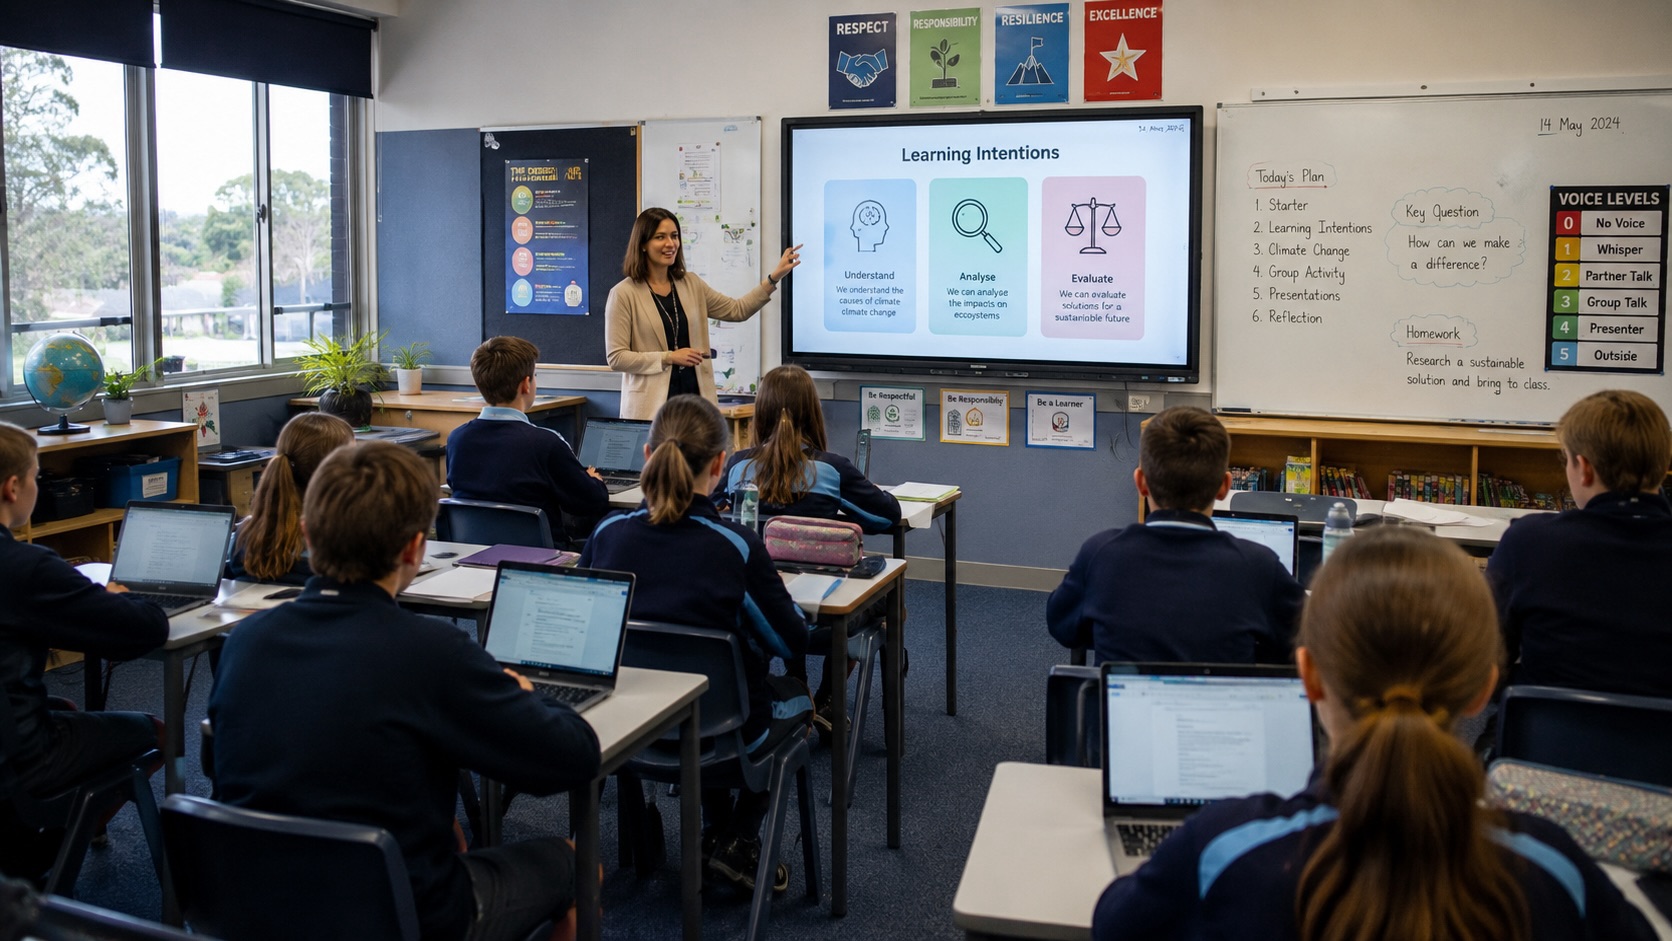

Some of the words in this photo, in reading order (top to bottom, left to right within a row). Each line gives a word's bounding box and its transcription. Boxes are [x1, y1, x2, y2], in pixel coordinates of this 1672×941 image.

[1001, 12, 1064, 26] RESILIENCE
[1089, 7, 1157, 21] EXCELLENCE
[837, 21, 888, 35] RESPECT
[913, 16, 978, 29] RESPONSIBILITY
[1539, 117, 1552, 132] 14
[1559, 117, 1583, 136] May
[1590, 117, 1620, 131] 2024
[901, 147, 971, 164] Learning
[976, 145, 1059, 161] Intentions
[1255, 169, 1295, 188] Today's
[1302, 169, 1324, 183] Plan
[1255, 199, 1263, 212] 1.
[1269, 199, 1309, 212] Starter
[1559, 193, 1602, 205] VOICE
[1607, 192, 1660, 205] LEVELS
[1405, 204, 1426, 222] Key
[1432, 204, 1479, 220] Question
[1253, 221, 1263, 234] 2.
[1269, 221, 1311, 239] Learning
[1318, 221, 1372, 234] Intentions
[1563, 217, 1573, 229] 0
[1596, 218, 1612, 228] No
[1615, 218, 1645, 228] Voice
[1408, 236, 1431, 249] How
[1437, 238, 1456, 249] can
[1463, 238, 1477, 248] we
[1483, 236, 1511, 249] make
[1253, 243, 1263, 256] 3.
[1268, 243, 1307, 257] Climate
[1312, 243, 1350, 262] Change
[1564, 243, 1570, 255] 1
[1598, 244, 1643, 257] Whisper
[1410, 261, 1418, 270] a
[1426, 257, 1487, 271] difference?
[845, 271, 895, 279] Understand
[960, 272, 996, 283] Analyse
[1072, 274, 1114, 283] Evaluate
[1253, 266, 1263, 278] 4.
[1268, 266, 1299, 283] Group
[1305, 266, 1346, 285] Activity
[1562, 270, 1571, 281] 2
[1586, 271, 1627, 281] Partner
[1630, 271, 1652, 281] Talk
[1059, 290, 1072, 298] We
[1253, 288, 1263, 301] 5.
[1269, 288, 1341, 302] Presentations
[949, 299, 962, 307] the
[1561, 296, 1570, 308] 3
[1587, 297, 1621, 310] Group
[1625, 297, 1647, 308] Talk
[1252, 311, 1263, 323] 6.
[1269, 311, 1323, 325] Reflection
[1406, 326, 1461, 341] Homework
[1560, 321, 1569, 333] 4
[1590, 323, 1644, 334] Presenter
[1406, 352, 1451, 367] Research
[1456, 358, 1464, 367] a
[1470, 356, 1525, 370] sustainable
[1560, 348, 1569, 360] 5
[1406, 373, 1446, 386] solution
[1452, 375, 1470, 387] and
[1477, 375, 1502, 395] bring
[1507, 376, 1518, 388] to
[1037, 398, 1047, 406] Be
